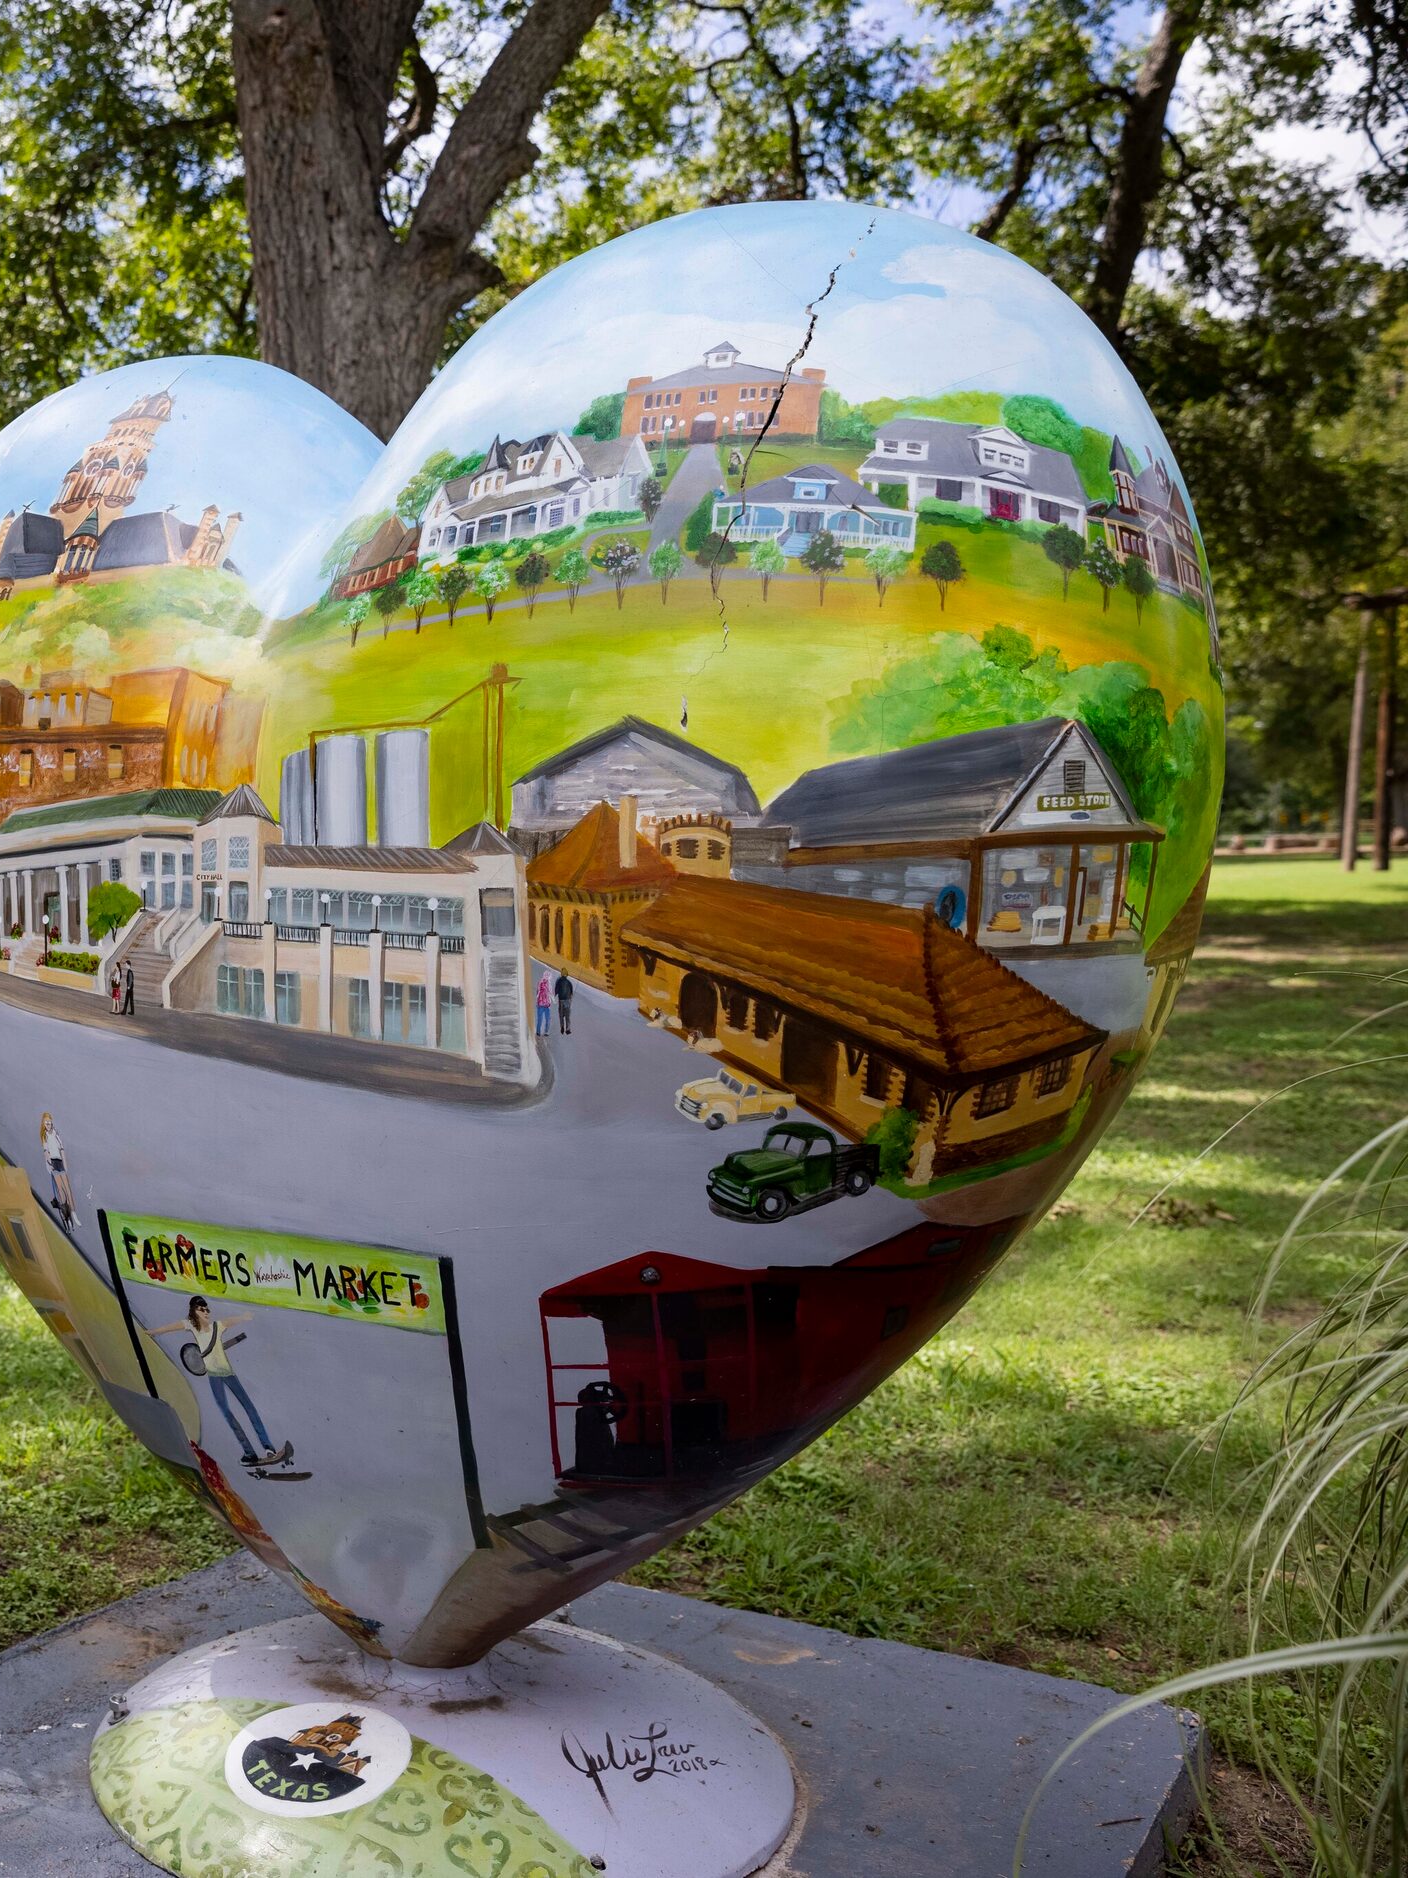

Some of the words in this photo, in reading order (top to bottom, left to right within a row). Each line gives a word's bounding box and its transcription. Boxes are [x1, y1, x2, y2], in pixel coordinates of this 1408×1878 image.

[1043, 796, 1075, 808] FEED
[1079, 795, 1110, 806] STORE
[196, 873, 210, 881] CITY
[210, 873, 223, 881] HALL
[123, 1233, 252, 1287] FARMERS
[293, 1258, 421, 1308] MARKET
[561, 1728, 647, 1822] Julie
[668, 1756, 708, 1773] 2018
[246, 1759, 330, 1801] TEXAS
